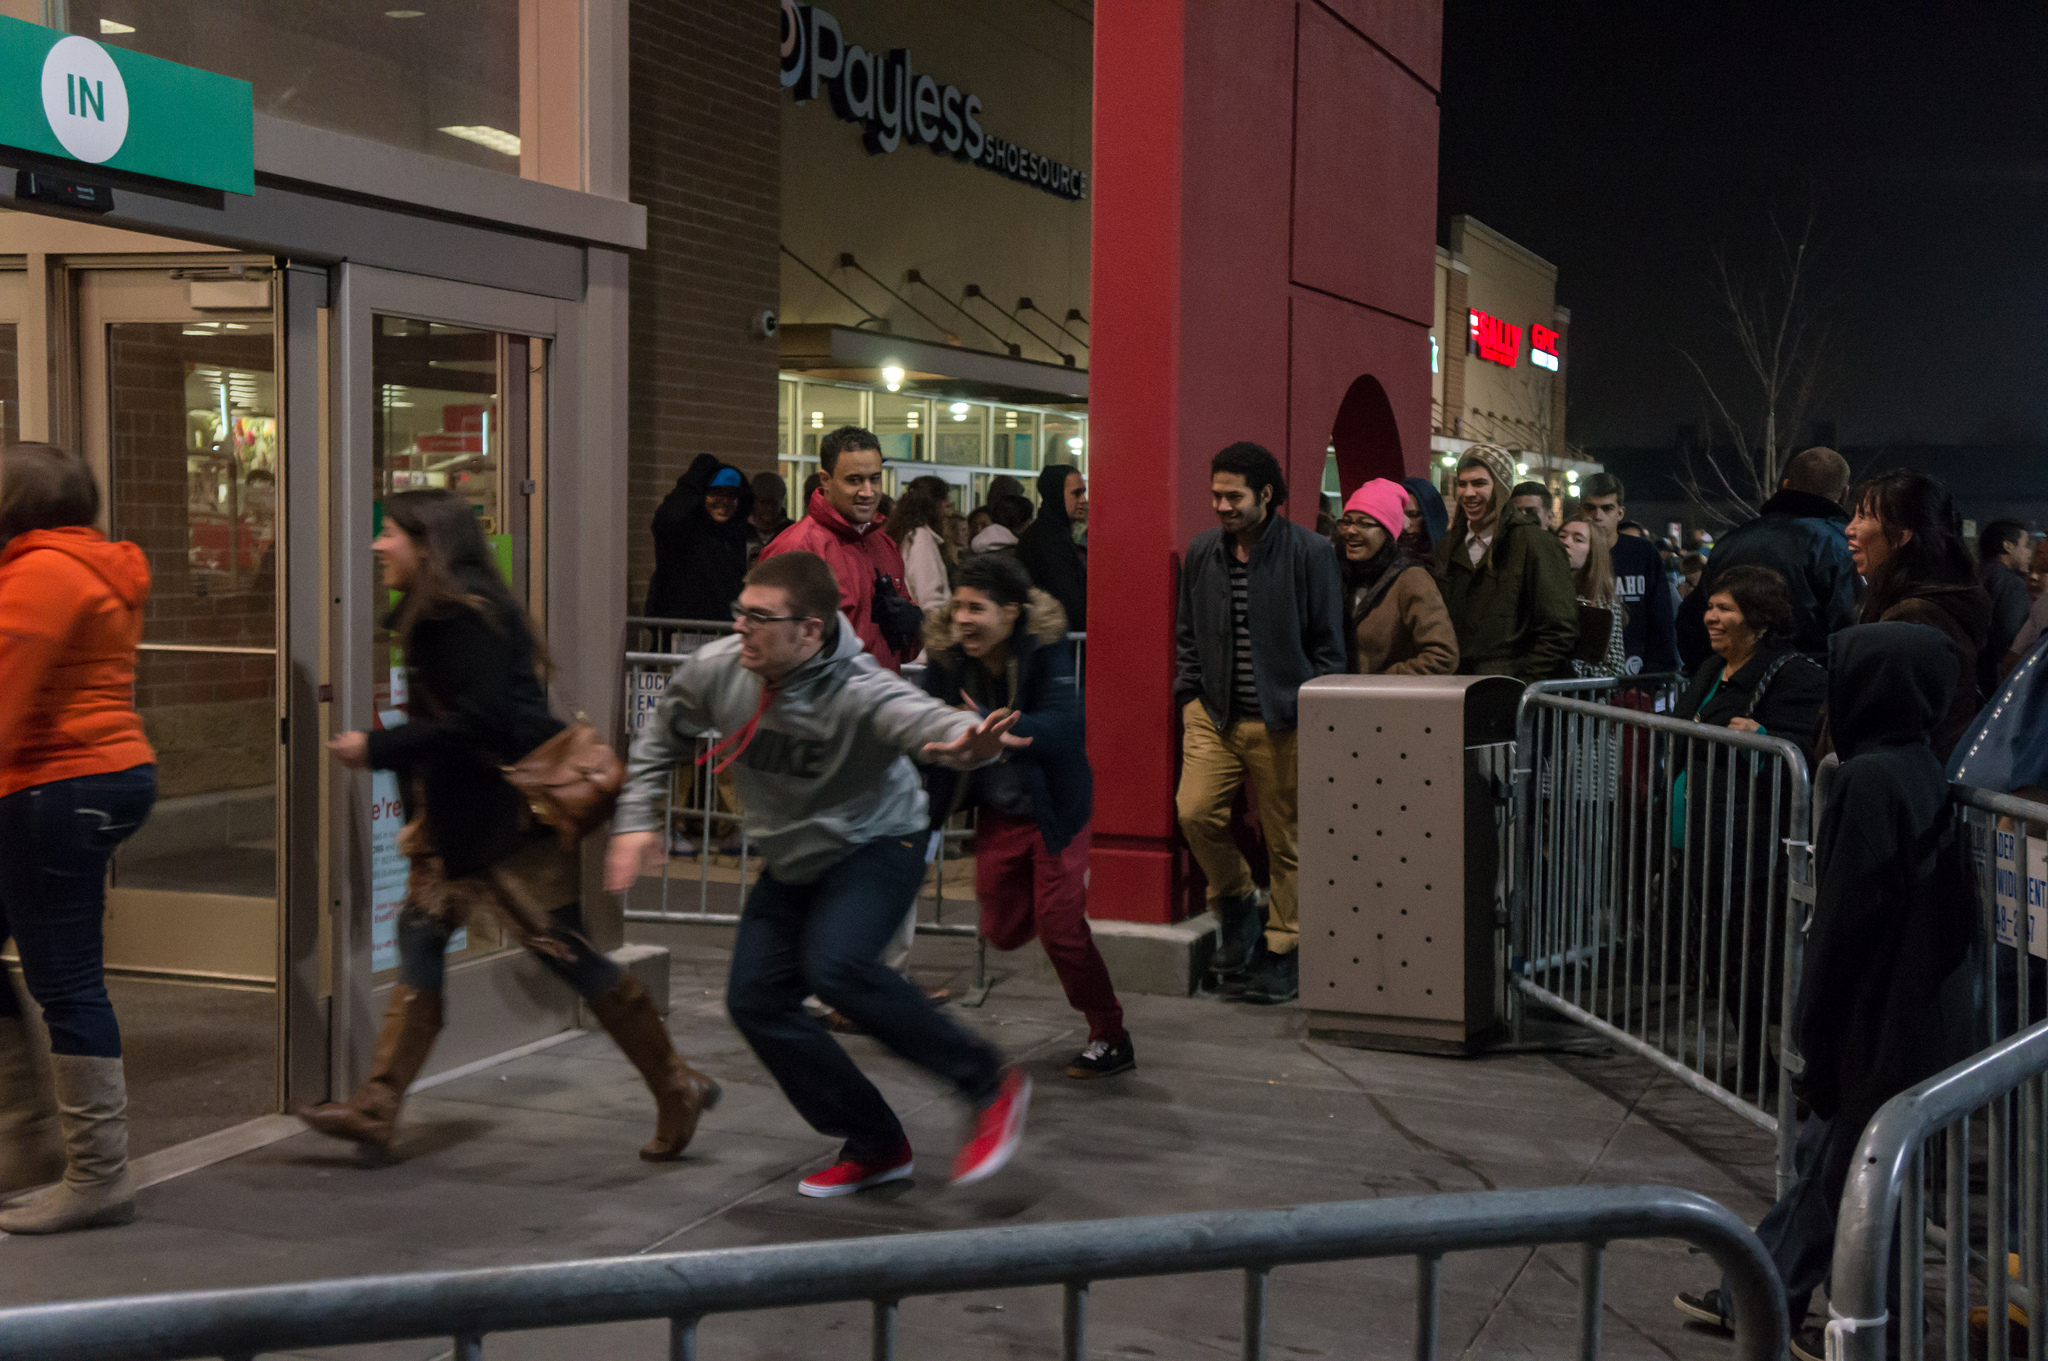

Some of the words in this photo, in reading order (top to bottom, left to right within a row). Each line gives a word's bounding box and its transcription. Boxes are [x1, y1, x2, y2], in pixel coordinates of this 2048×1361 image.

[67, 73, 104, 122] IN
[811, 6, 982, 159] Payless
[983, 134, 1087, 199] SHOESOURCE
[1478, 311, 1522, 358] SALLY
[1614, 575, 1646, 596] AHO
[372, 797, 402, 821] e're
